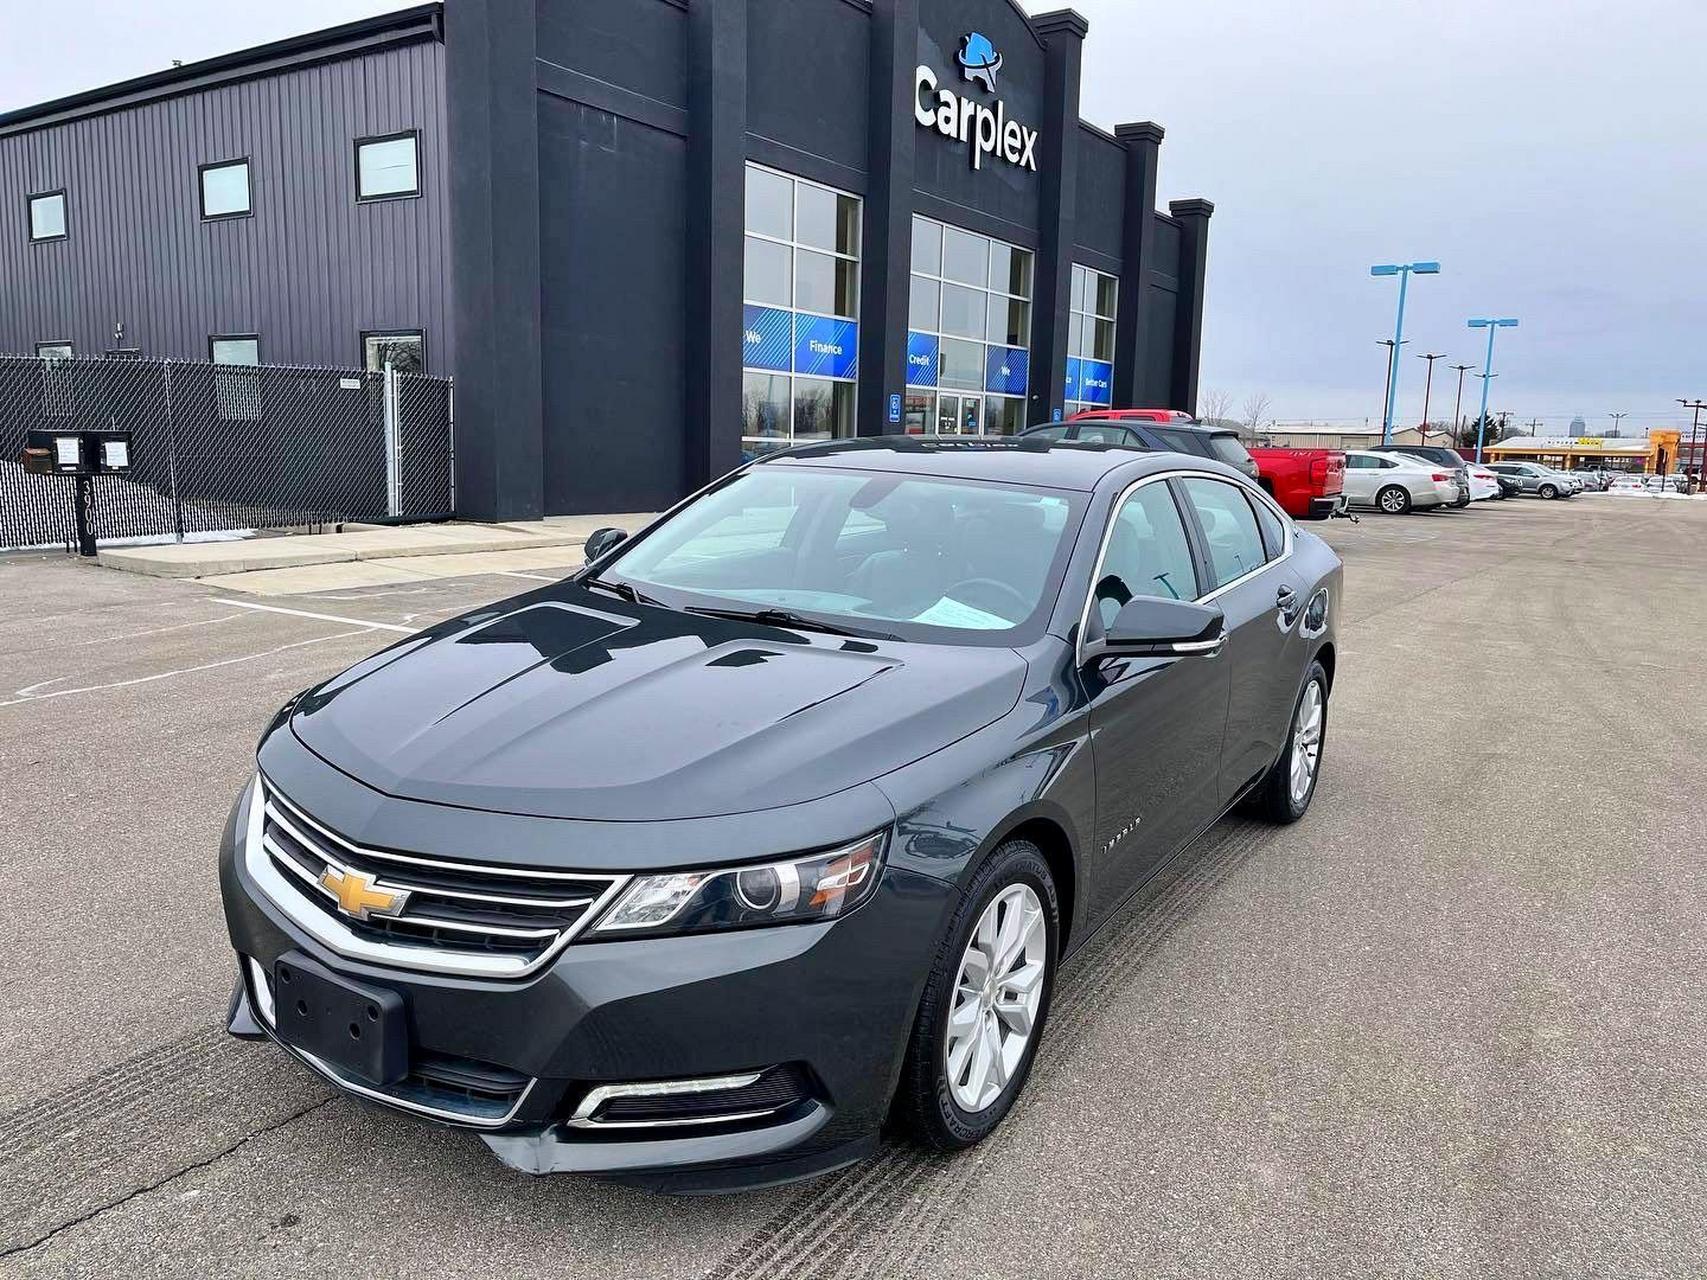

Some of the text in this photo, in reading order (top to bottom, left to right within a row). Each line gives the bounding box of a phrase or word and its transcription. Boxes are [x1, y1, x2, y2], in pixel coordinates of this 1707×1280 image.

[915, 65, 1037, 171] Carplex
[746, 330, 843, 355] We Finance
[909, 354, 929, 366] Credit
[83, 481, 94, 535] 3900
